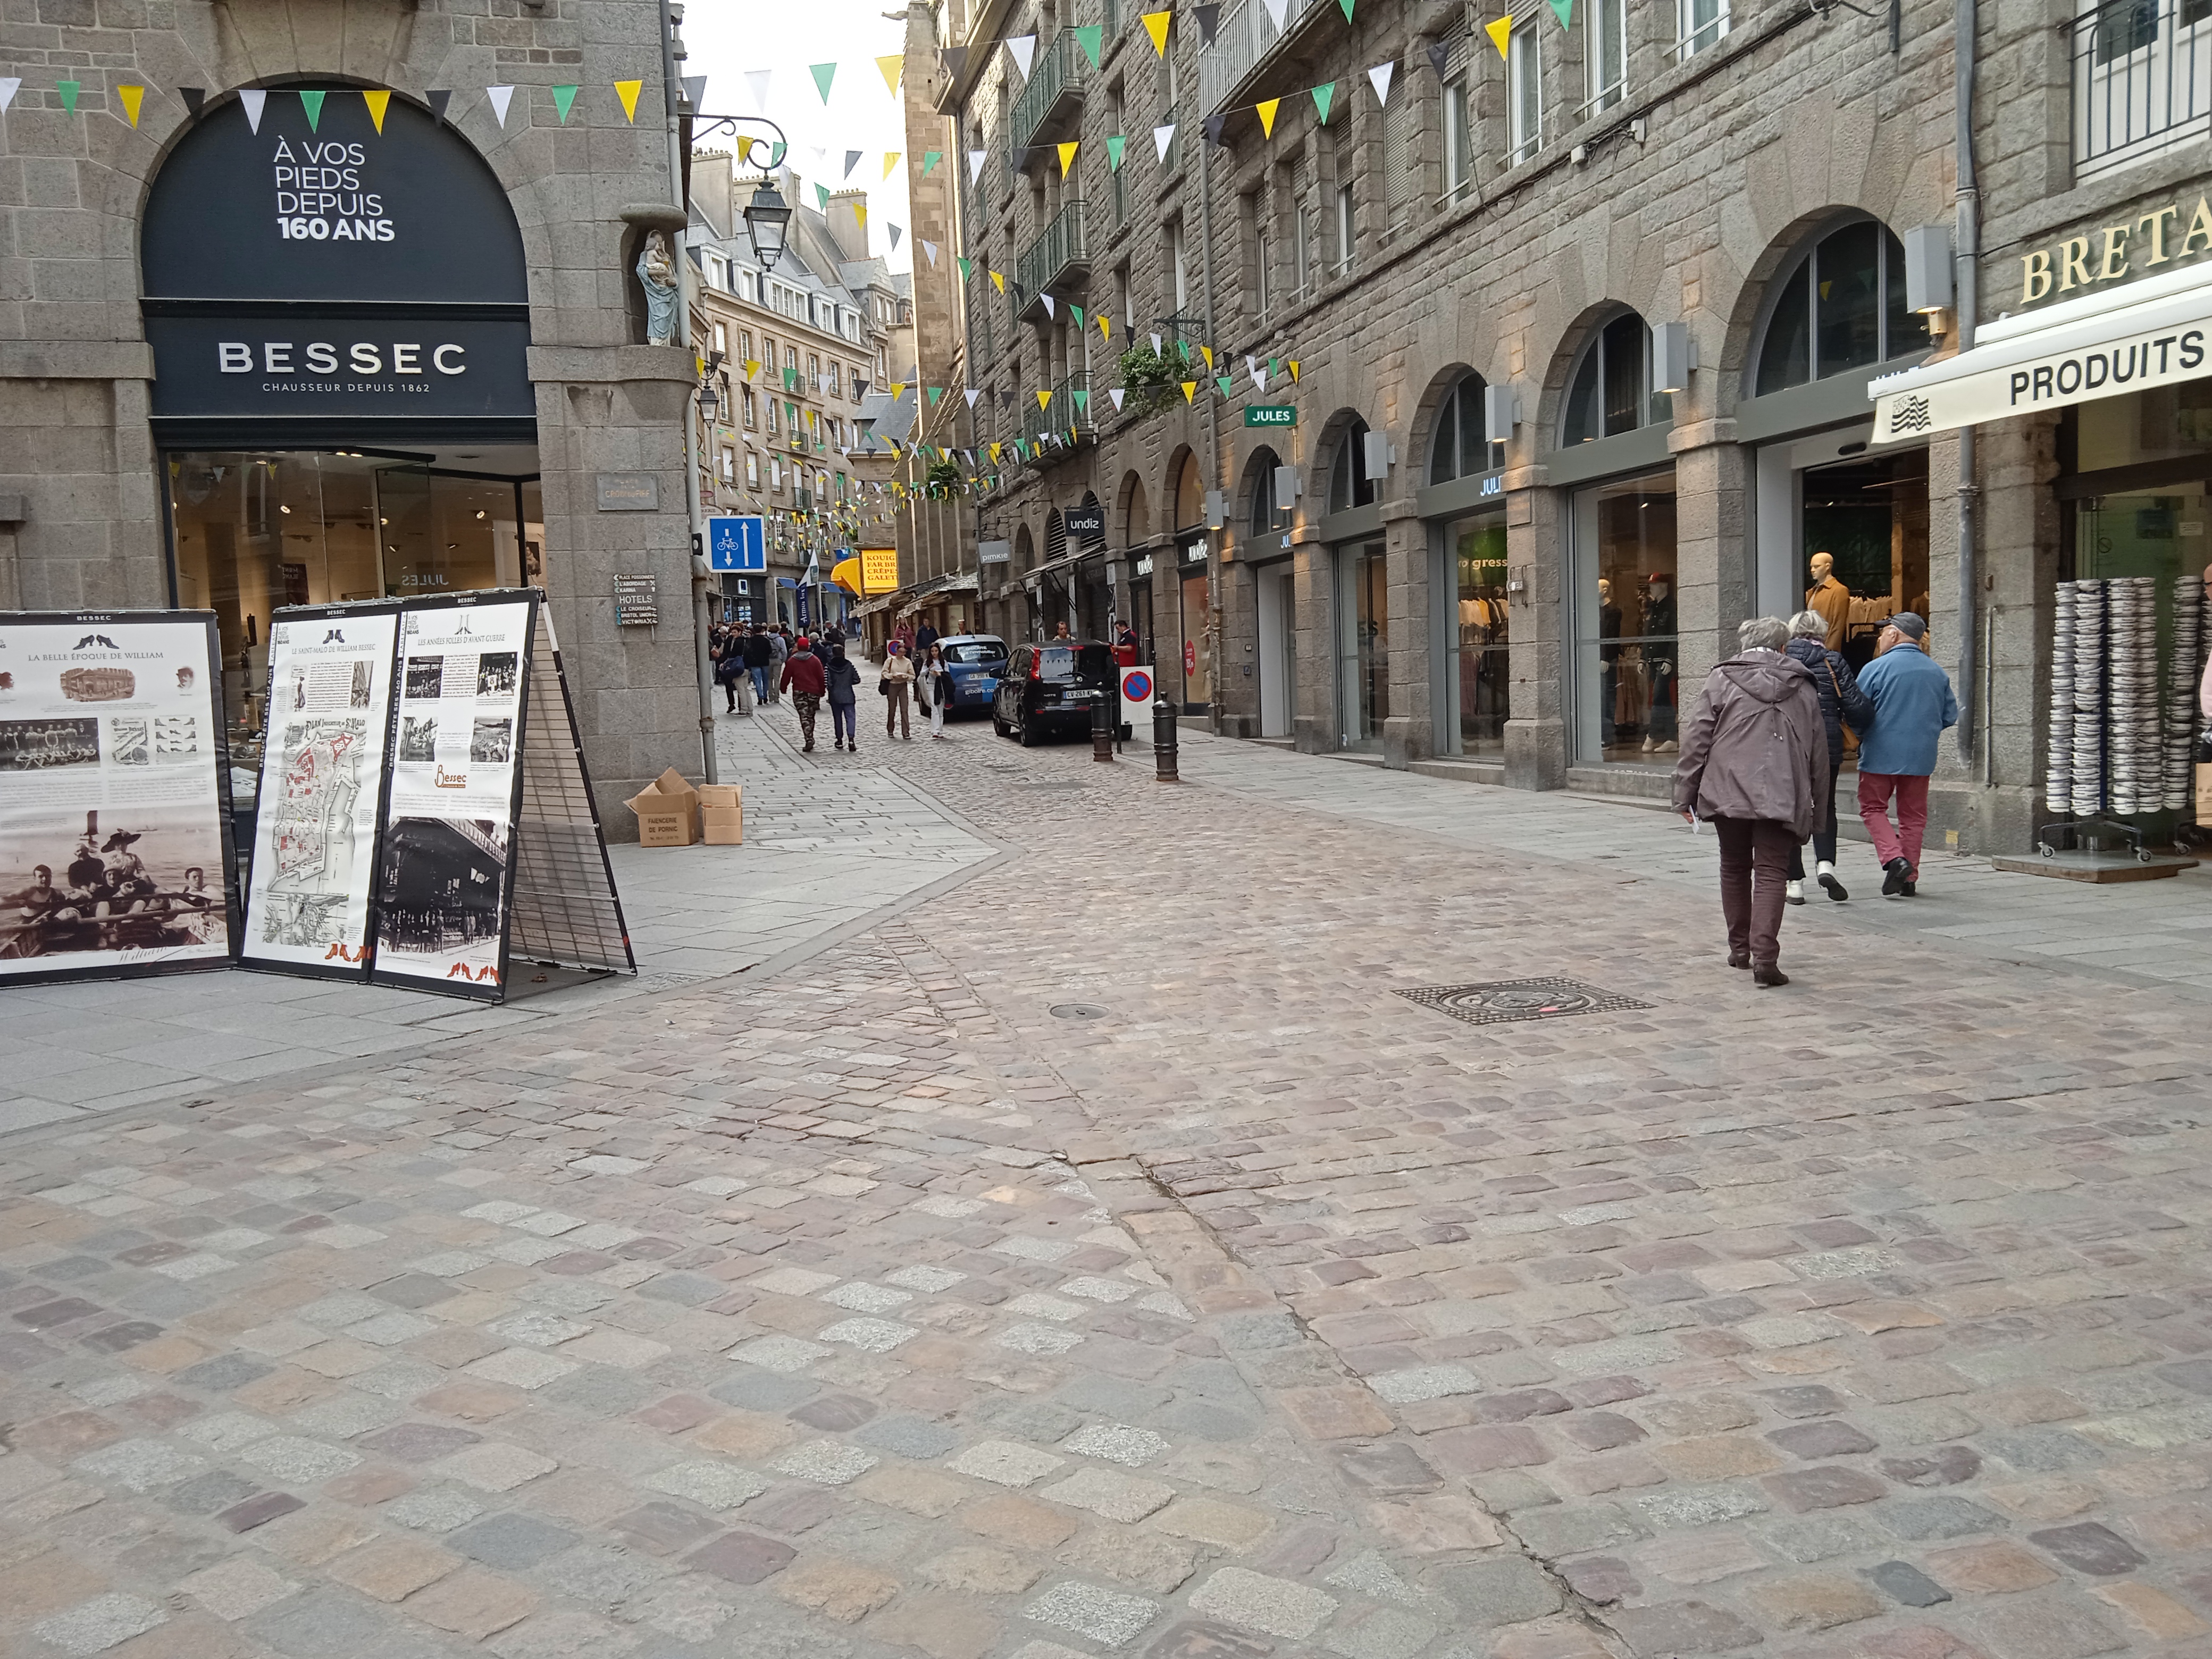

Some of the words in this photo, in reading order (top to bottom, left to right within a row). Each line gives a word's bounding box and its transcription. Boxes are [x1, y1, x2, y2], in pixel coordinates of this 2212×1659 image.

[273, 135, 296, 163] À
[303, 141, 365, 165] VOS
[276, 166, 359, 191] PIEDS
[277, 191, 383, 216] DEPUIS
[277, 217, 329, 240] 160
[332, 219, 395, 241] ANS
[218, 341, 466, 376] BESSEC
[2010, 330, 2204, 406] PRODUITS
[262, 383, 341, 392] CHAUSSEUR
[347, 383, 395, 392] DEPUIS
[401, 383, 430, 392] 1862
[1252, 410, 1290, 421] JULES
[1070, 518, 1099, 529] undiz
[982, 552, 1008, 562] pimkie
[619, 595, 652, 604] HOTELS
[426, 636, 445, 645] ANNÉES
[434, 764, 467, 787] Bessec
